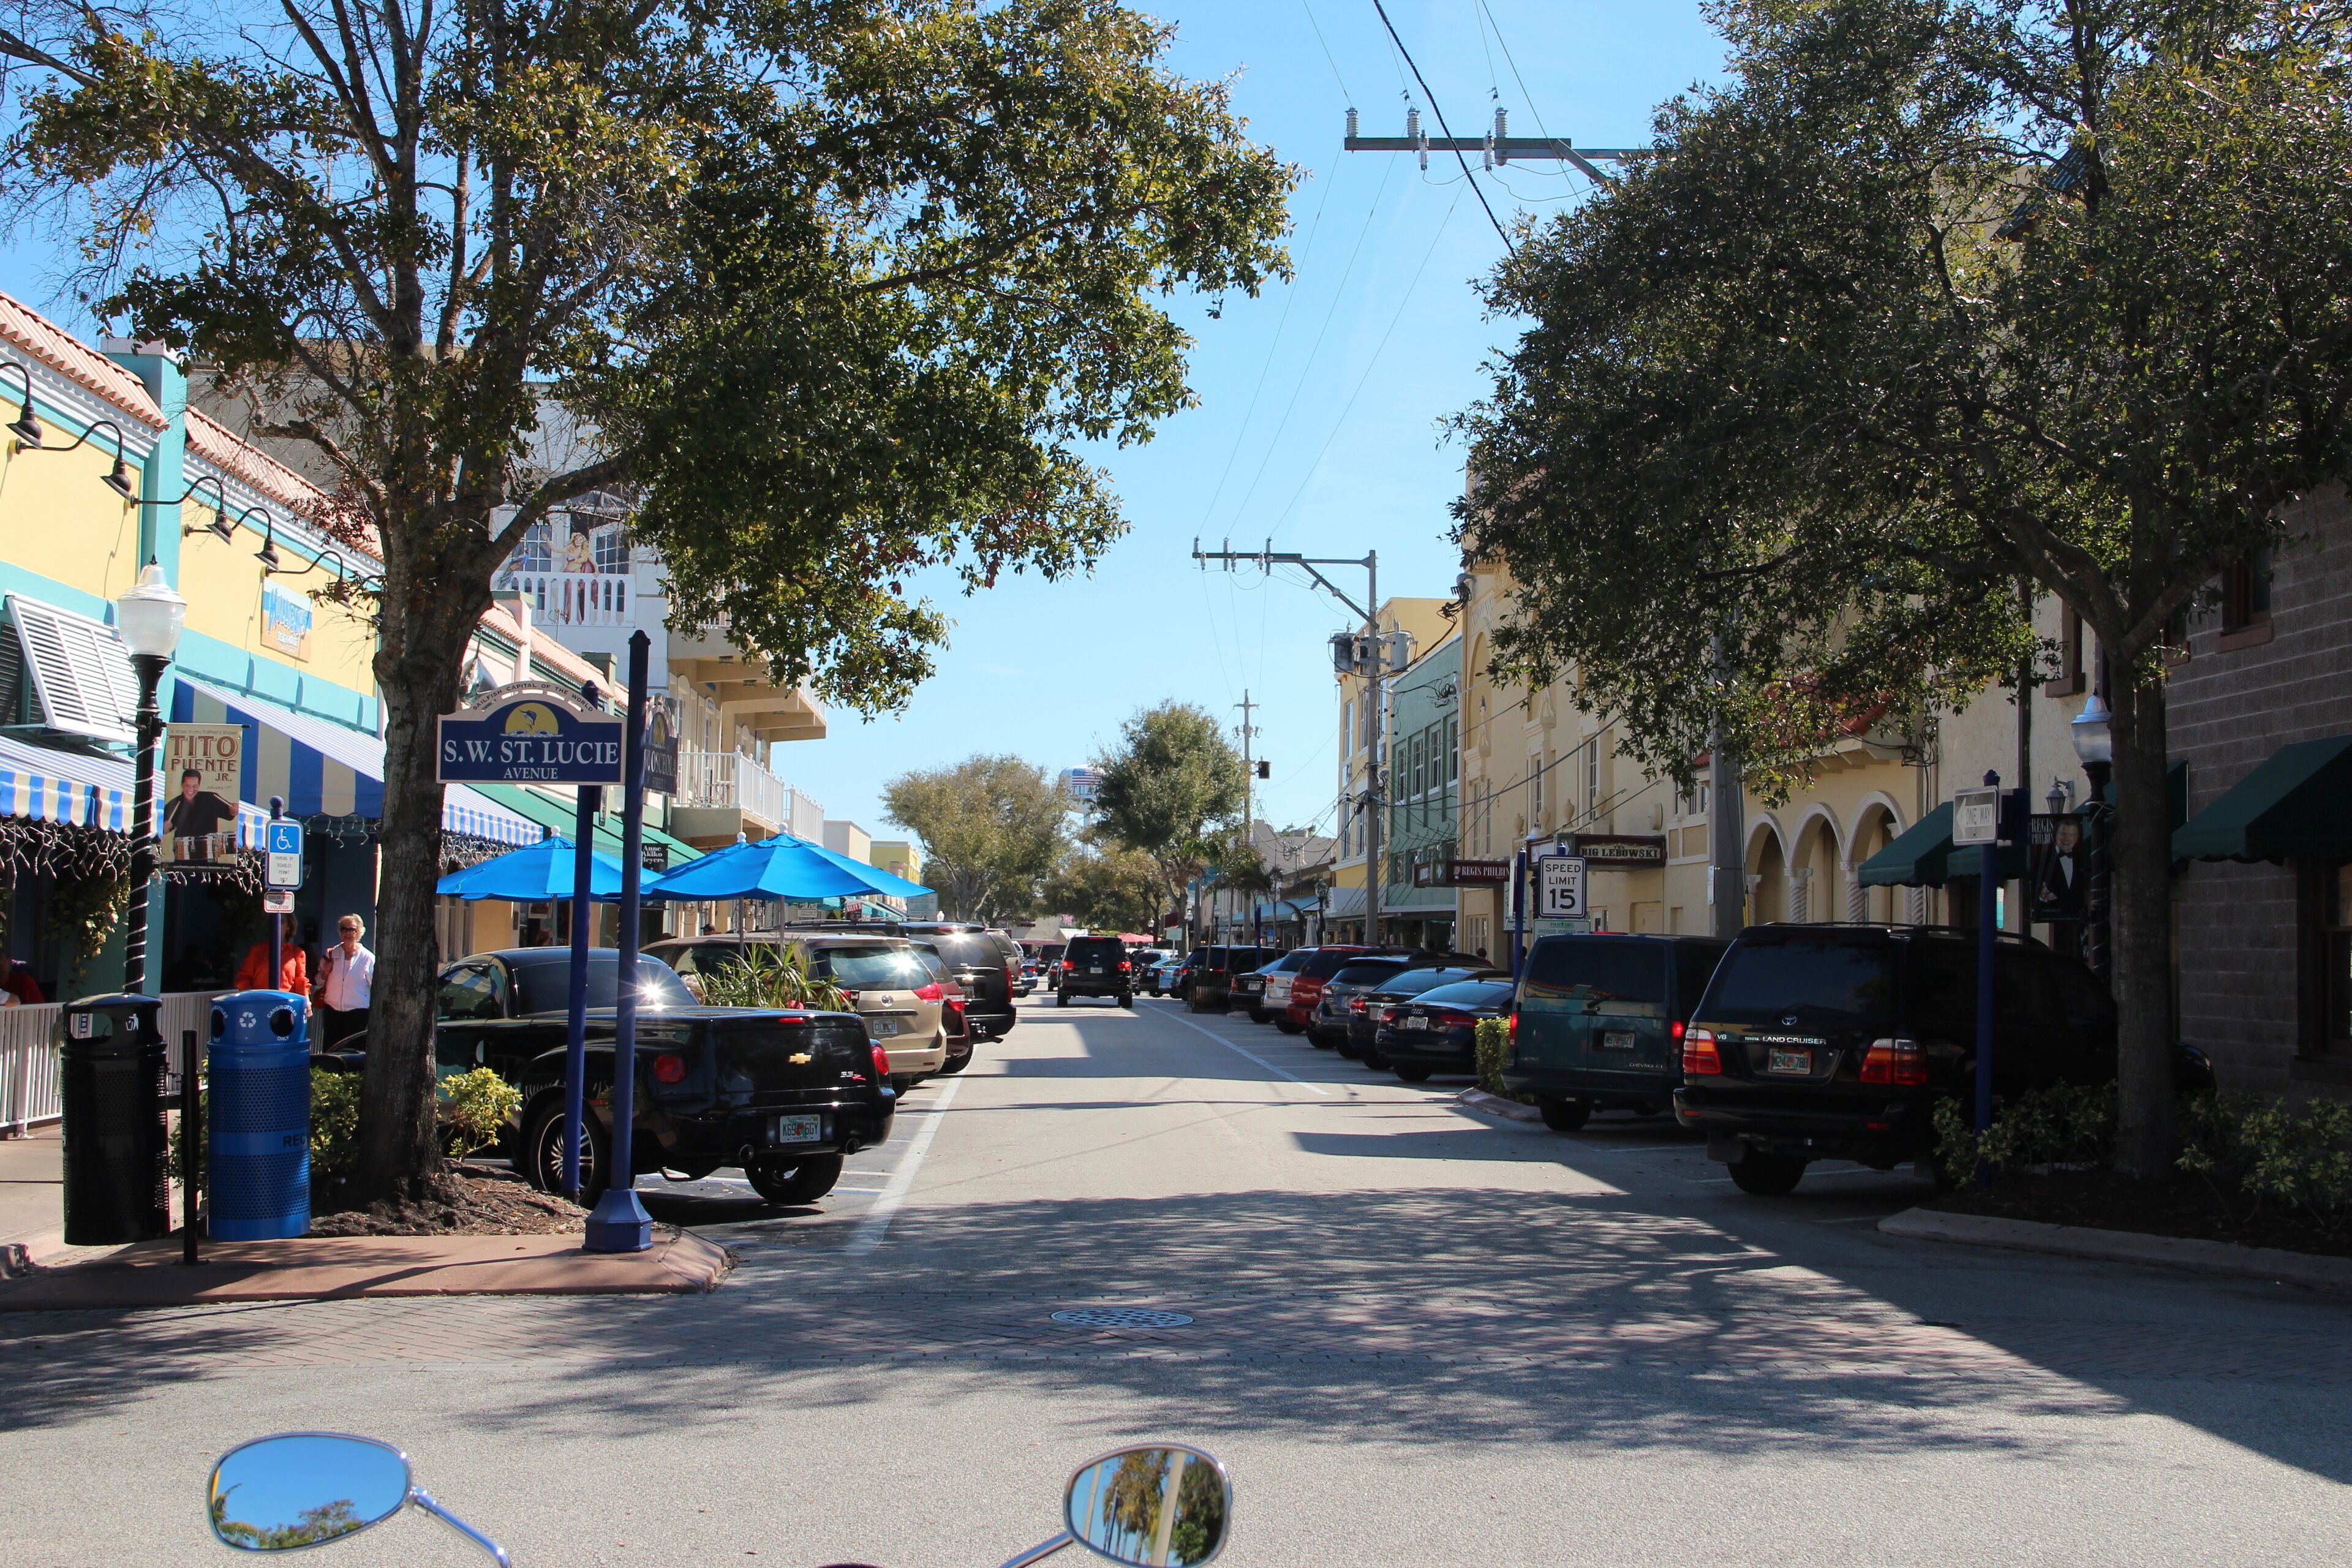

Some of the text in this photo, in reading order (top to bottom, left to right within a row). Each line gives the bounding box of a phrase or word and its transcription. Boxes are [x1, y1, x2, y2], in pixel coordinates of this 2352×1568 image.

[473, 690, 502, 710] SAILFISH
[571, 694, 594, 712] WORLD
[170, 735, 238, 759] TITO
[444, 740, 619, 764] S.W. ST. LUCIE
[172, 759, 237, 772] PUENTE
[503, 767, 559, 779] AVENUE
[1966, 807, 1991, 825] ONE WAY
[2031, 818, 2054, 833] REGIS
[1462, 866, 1482, 876] REGIS
[1545, 864, 1581, 873] SPEED
[1549, 876, 1577, 885] LIMIT
[1550, 889, 1576, 910] 15
[267, 1005, 298, 1018] CANS/BOTTLES
[783, 1123, 796, 1136] K69
